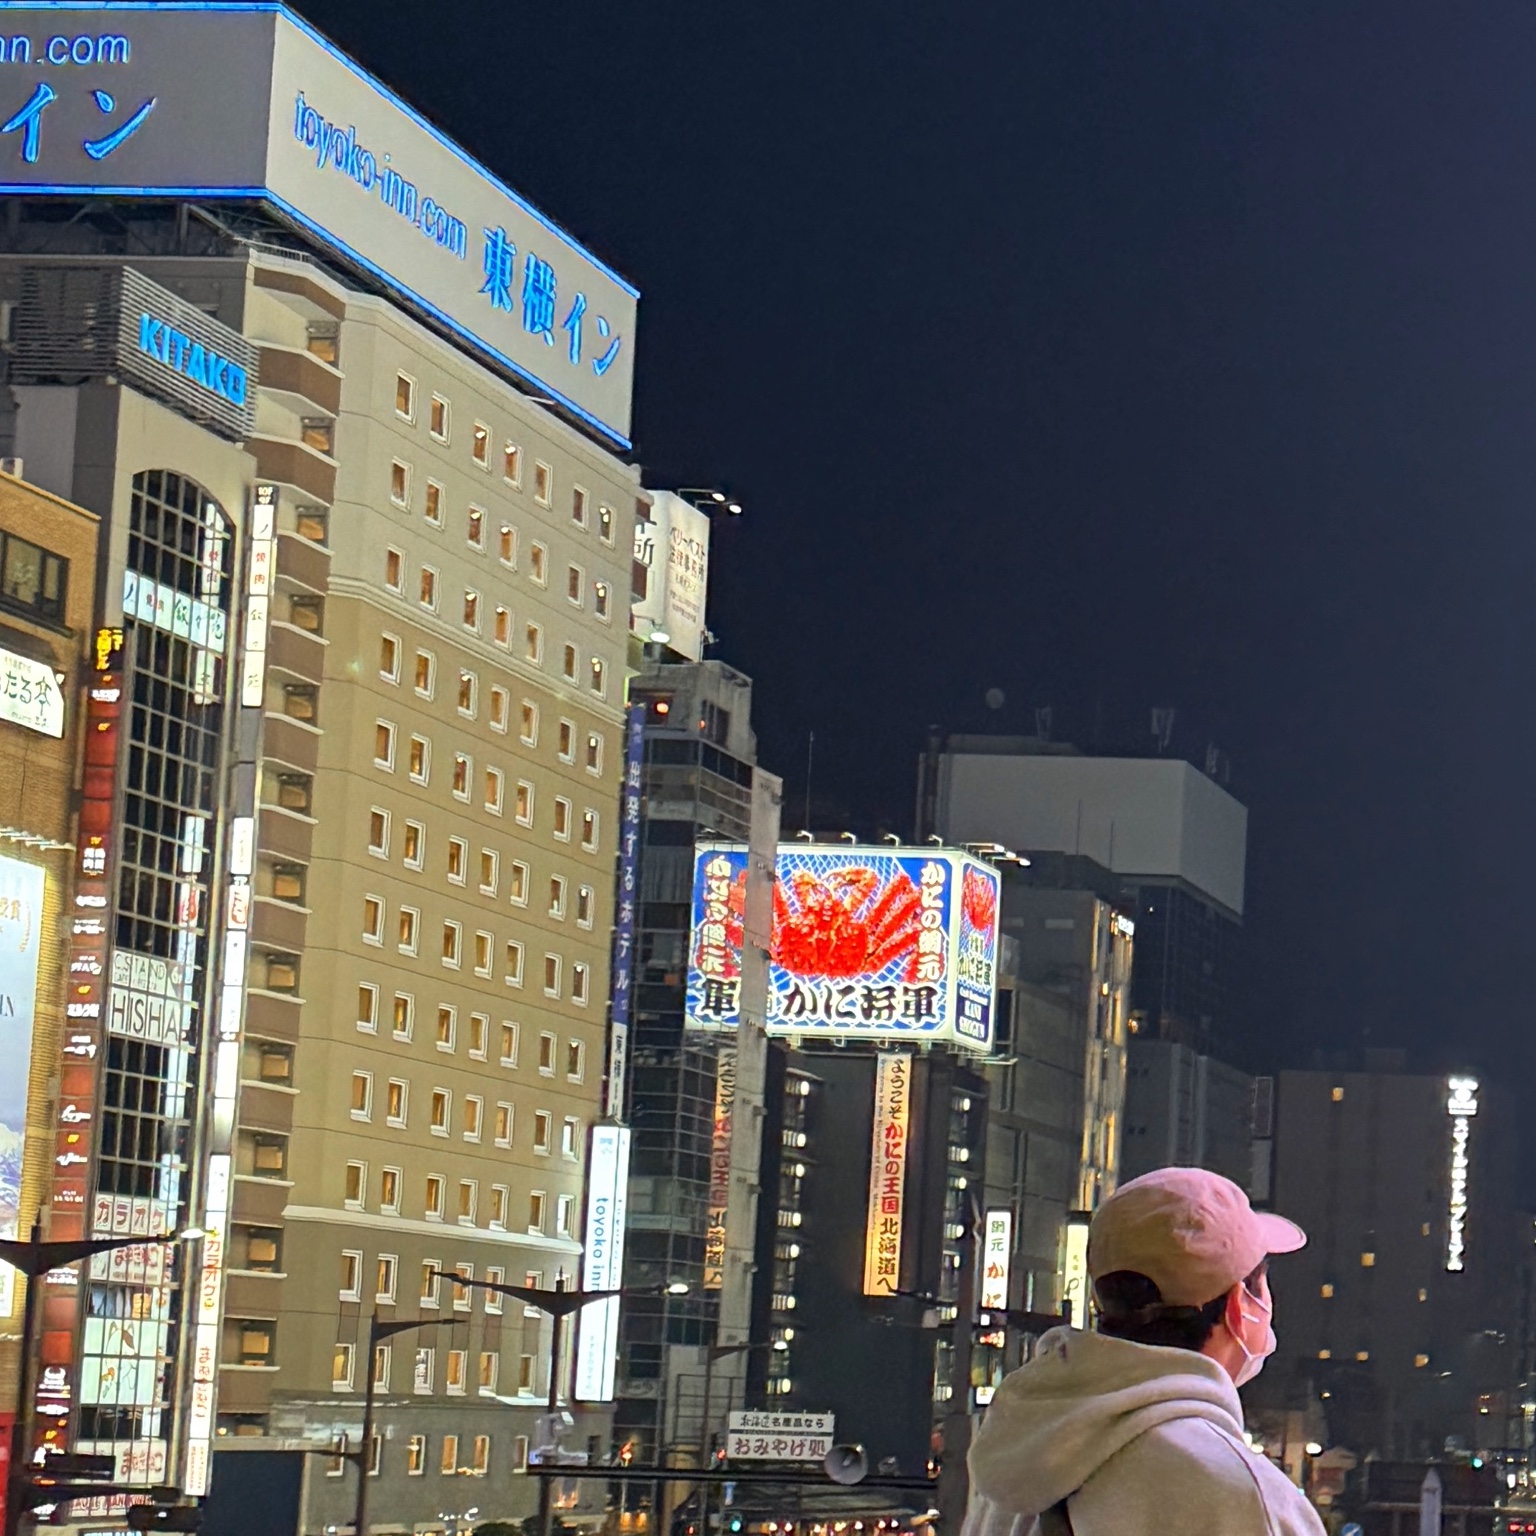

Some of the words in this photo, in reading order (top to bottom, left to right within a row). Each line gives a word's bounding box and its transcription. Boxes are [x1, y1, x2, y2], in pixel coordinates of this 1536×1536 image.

[0, 81, 157, 162] イン
[294, 90, 468, 260] toyoko-inn.com
[478, 225, 621, 377] 東横イン
[138, 312, 247, 407] KITAKO
[915, 861, 946, 982] かにの網元
[783, 981, 940, 1024] かに将軍
[594, 1196, 609, 1259] toyoko
